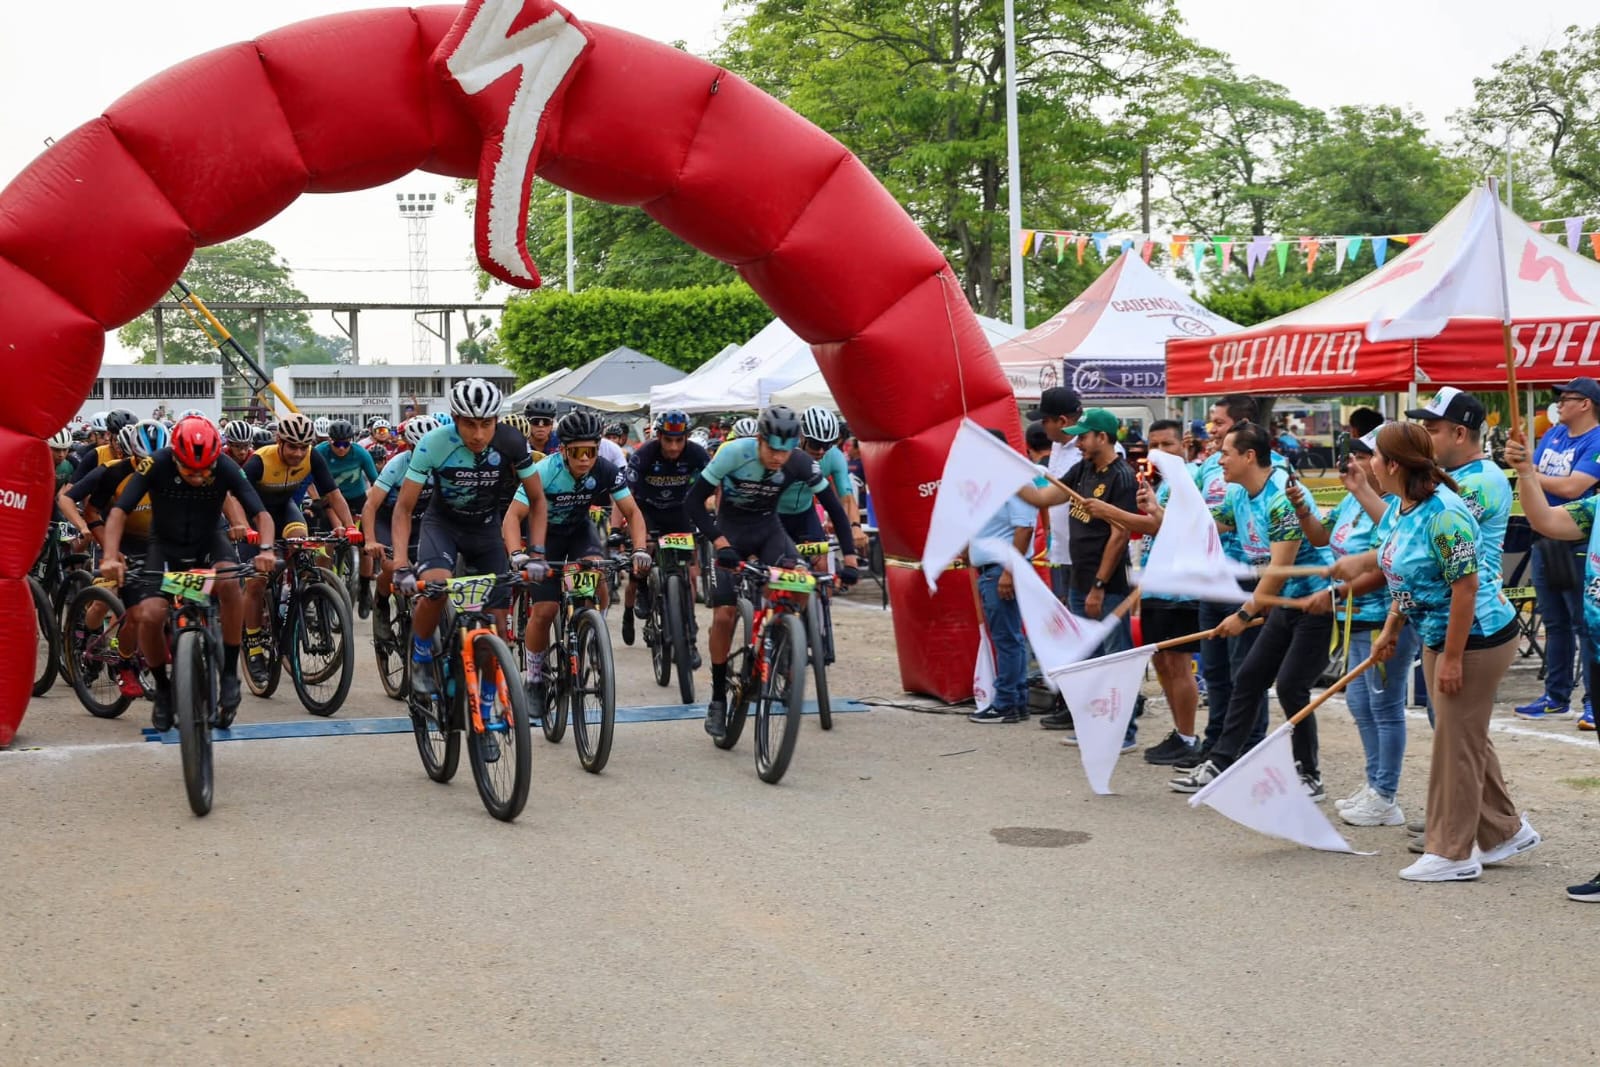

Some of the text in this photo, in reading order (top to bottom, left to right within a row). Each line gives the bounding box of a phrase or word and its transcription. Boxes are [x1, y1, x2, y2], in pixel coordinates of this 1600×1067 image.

[1204, 331, 1363, 383] SPECIALIZED
[361, 398, 390, 406] OFICINA
[455, 471, 500, 479] ORCAS
[664, 537, 688, 546] 333
[798, 544, 821, 556] 251
[171, 573, 206, 592] 289
[573, 572, 596, 589] 241
[452, 578, 492, 606] 372
